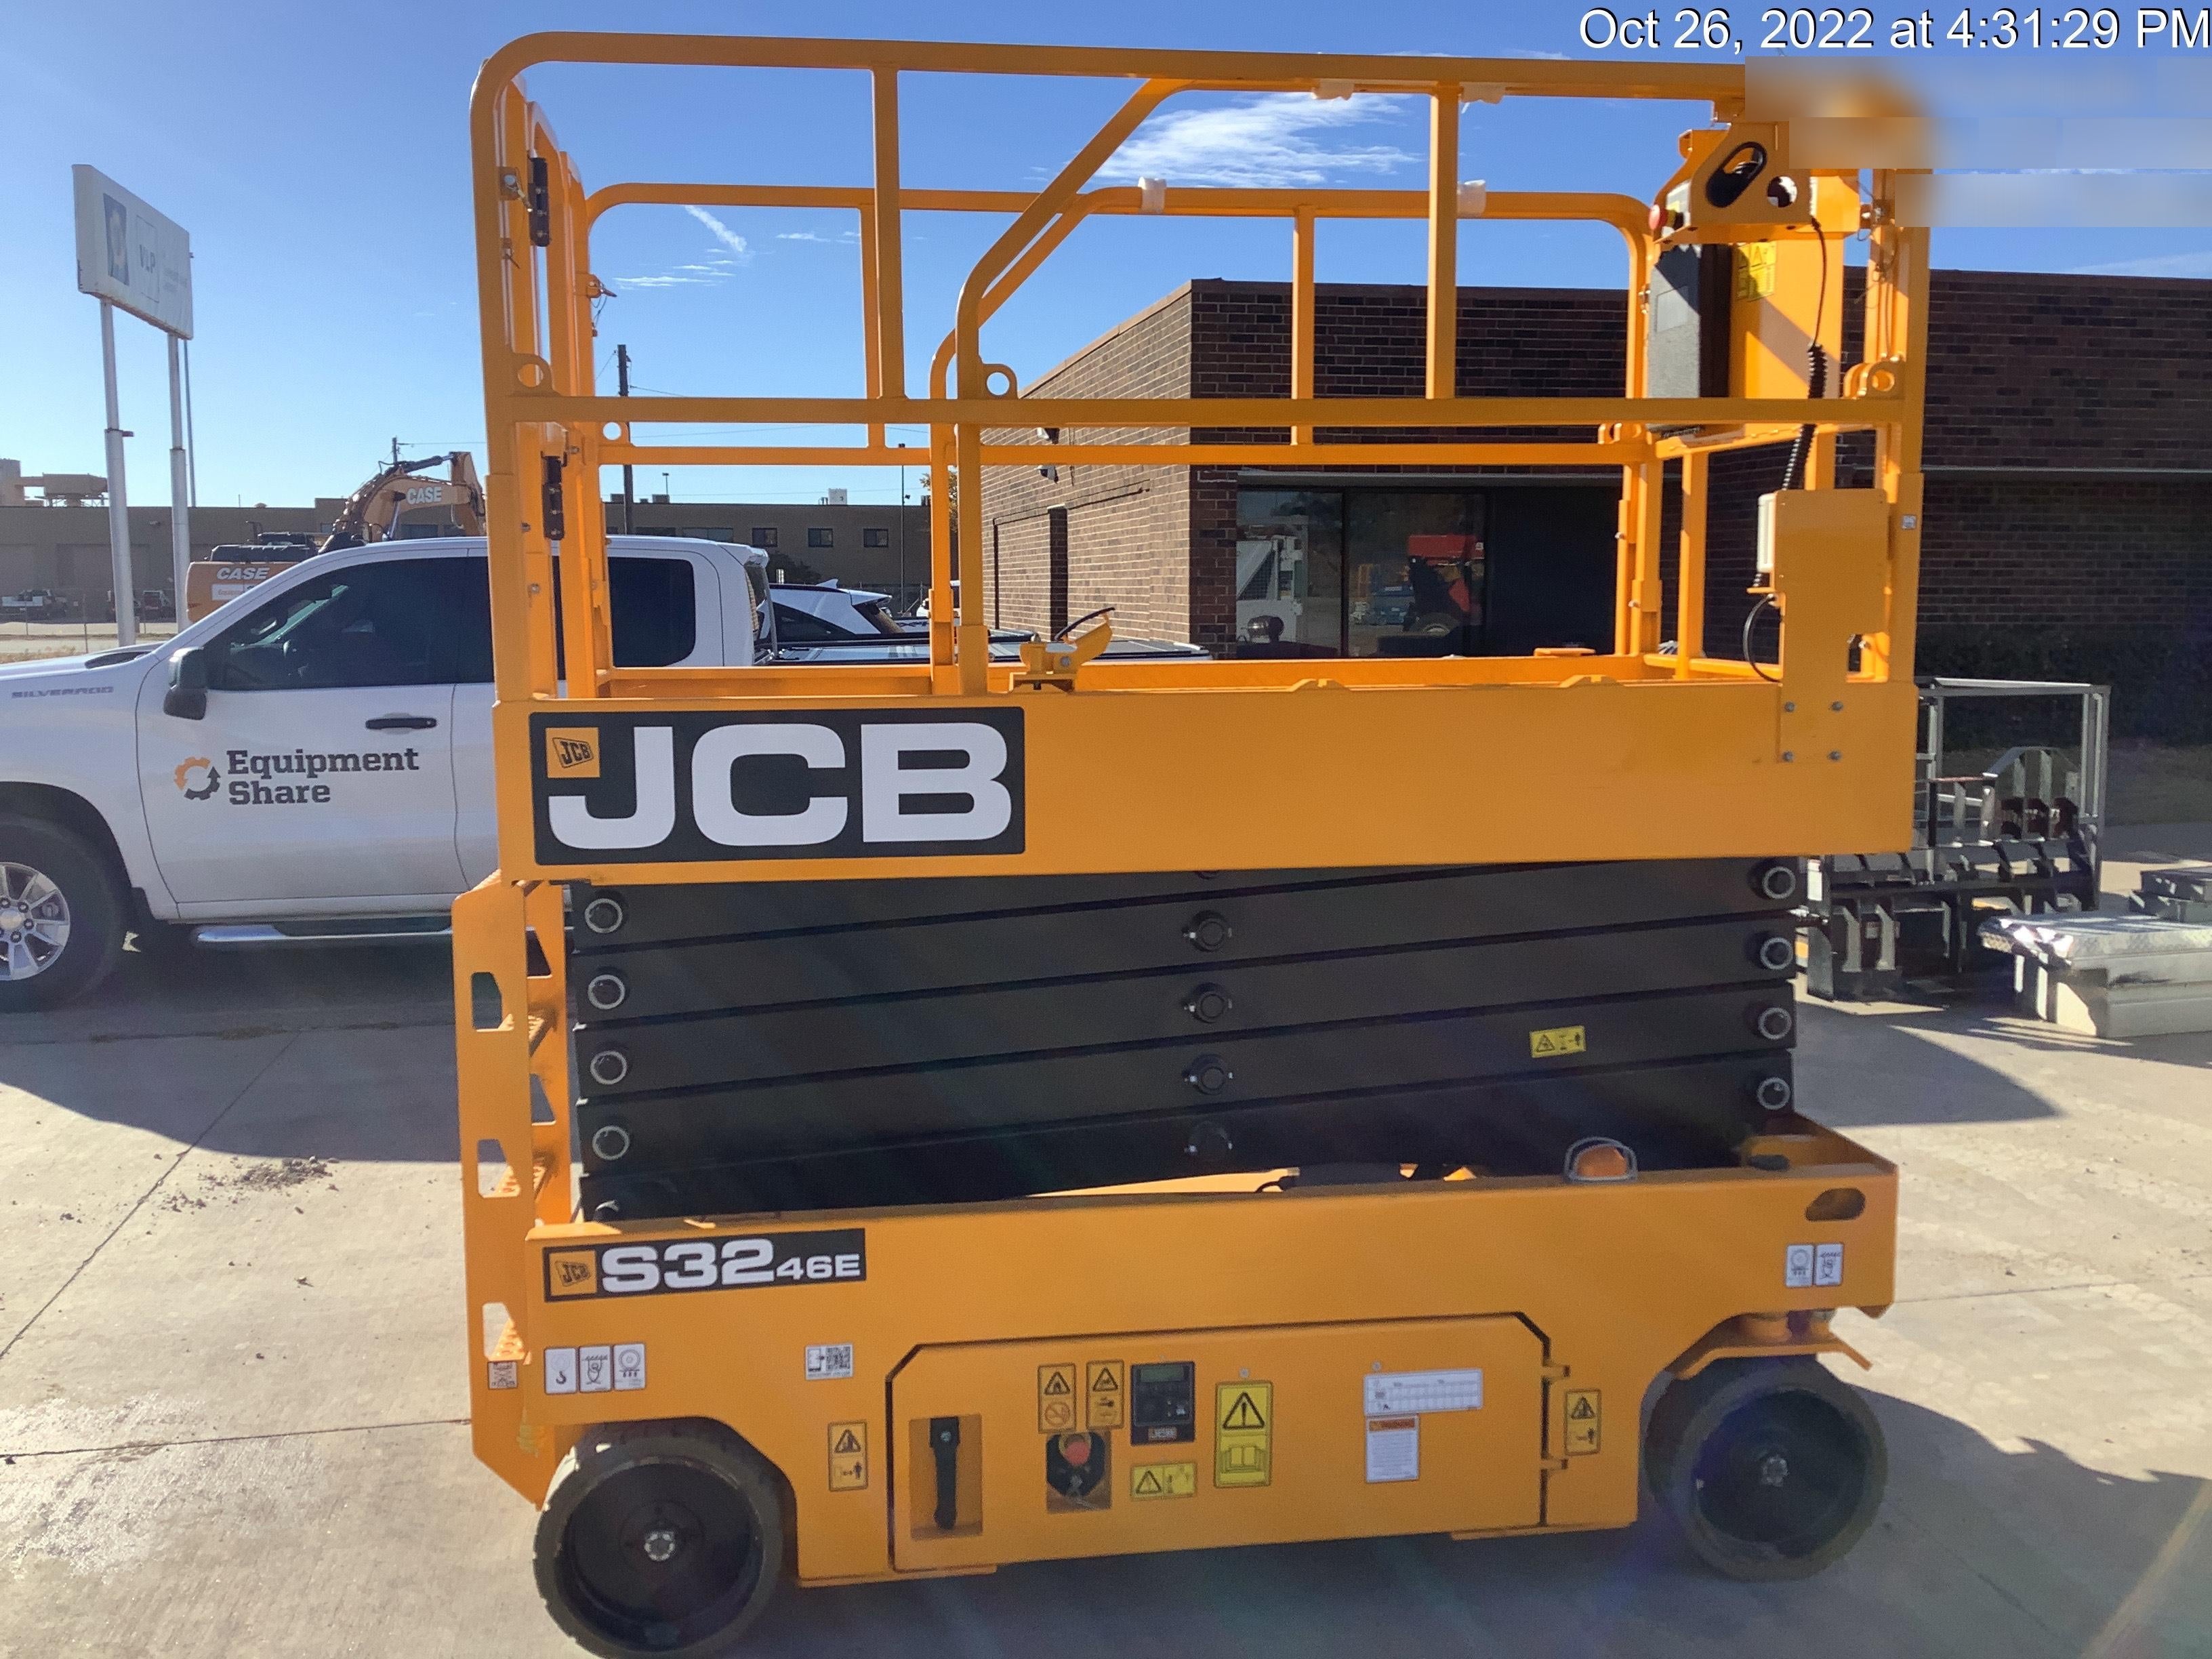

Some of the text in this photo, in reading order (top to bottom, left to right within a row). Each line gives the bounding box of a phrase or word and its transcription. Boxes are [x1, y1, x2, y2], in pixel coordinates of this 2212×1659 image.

[406, 486, 442, 505] CASE
[216, 567, 270, 581] CASE
[11, 686, 115, 699] SILVERADO
[226, 747, 420, 779] Equipment
[560, 740, 591, 765] JCB
[228, 780, 331, 805] Share
[548, 722, 1012, 850] JCB
[562, 1264, 590, 1284] JCB
